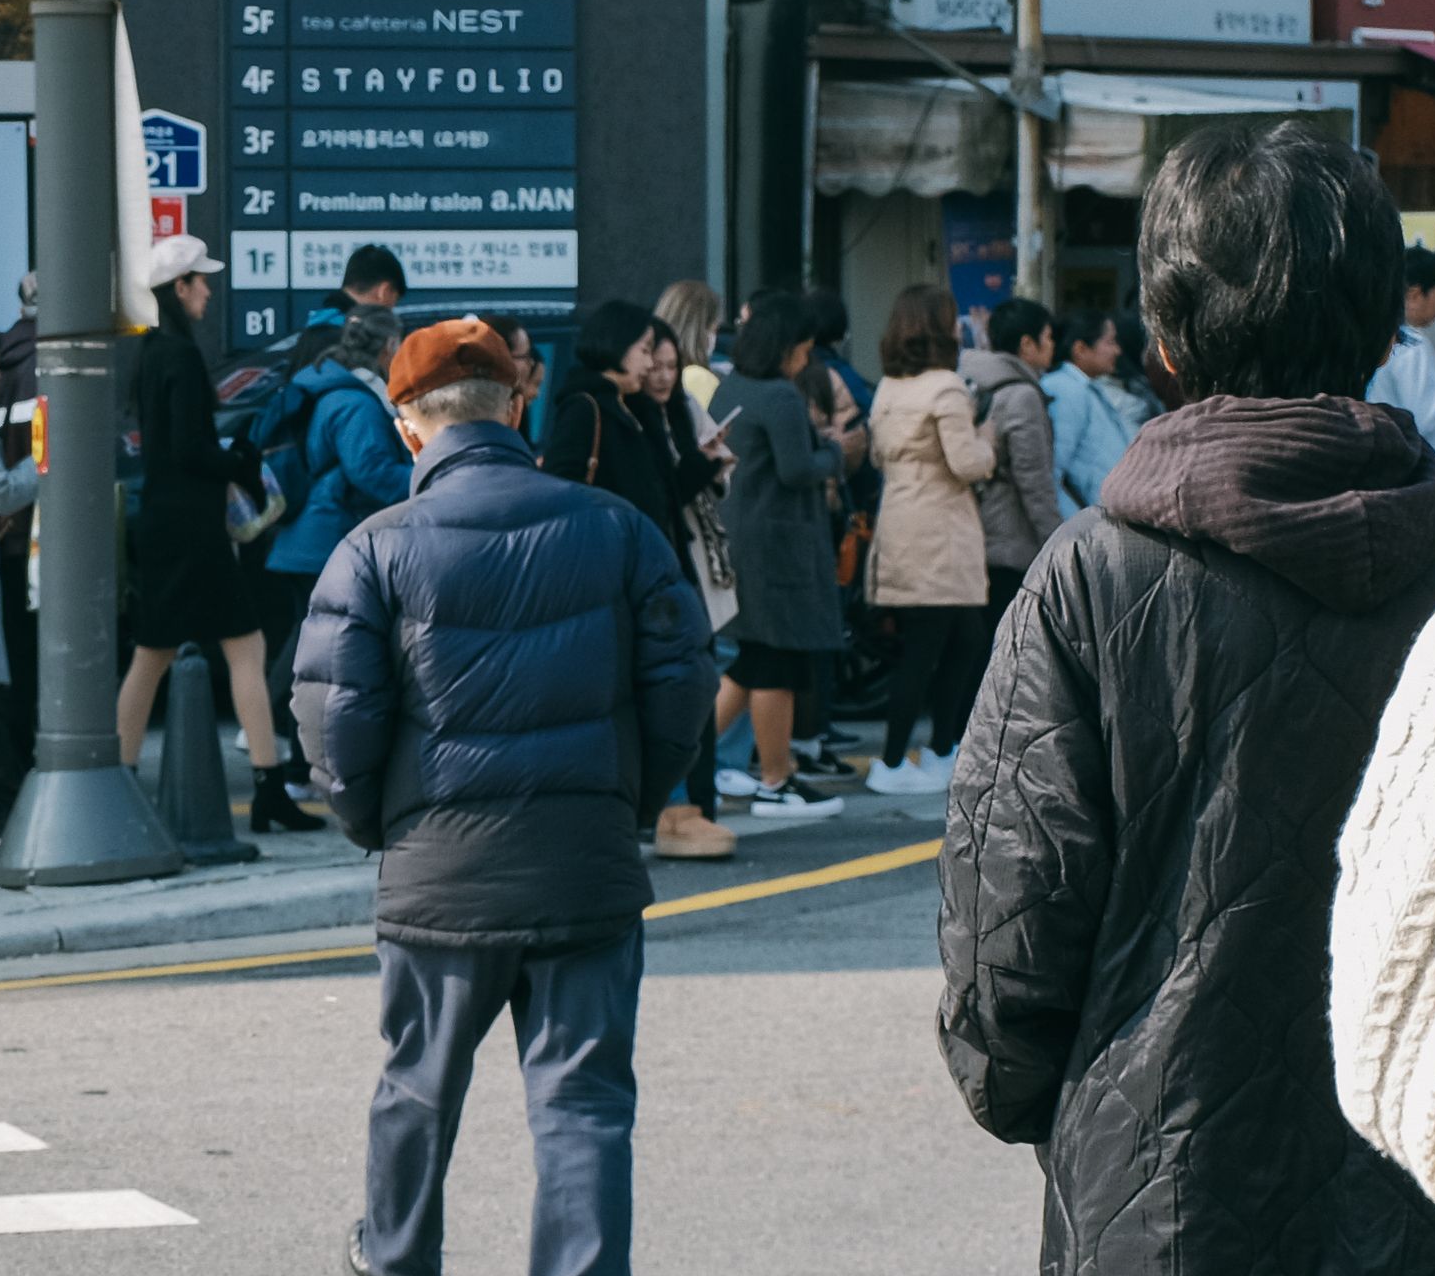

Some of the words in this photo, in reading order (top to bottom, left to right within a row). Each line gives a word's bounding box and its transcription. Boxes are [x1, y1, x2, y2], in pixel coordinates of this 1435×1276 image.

[242, 5, 275, 35] 5F
[301, 15, 334, 31] tea
[339, 14, 427, 32] cafeteria
[432, 8, 524, 34] NEST
[241, 65, 275, 95] 4F
[301, 67, 563, 93] STAYFOLIO
[243, 126, 275, 155] 3F
[243, 186, 275, 215] 2F
[298, 191, 386, 212] Premium
[388, 191, 428, 212] hair
[430, 191, 483, 212] salon
[489, 187, 575, 212] a.NAN
[246, 248, 275, 275] 1F
[245, 307, 276, 336] B1
